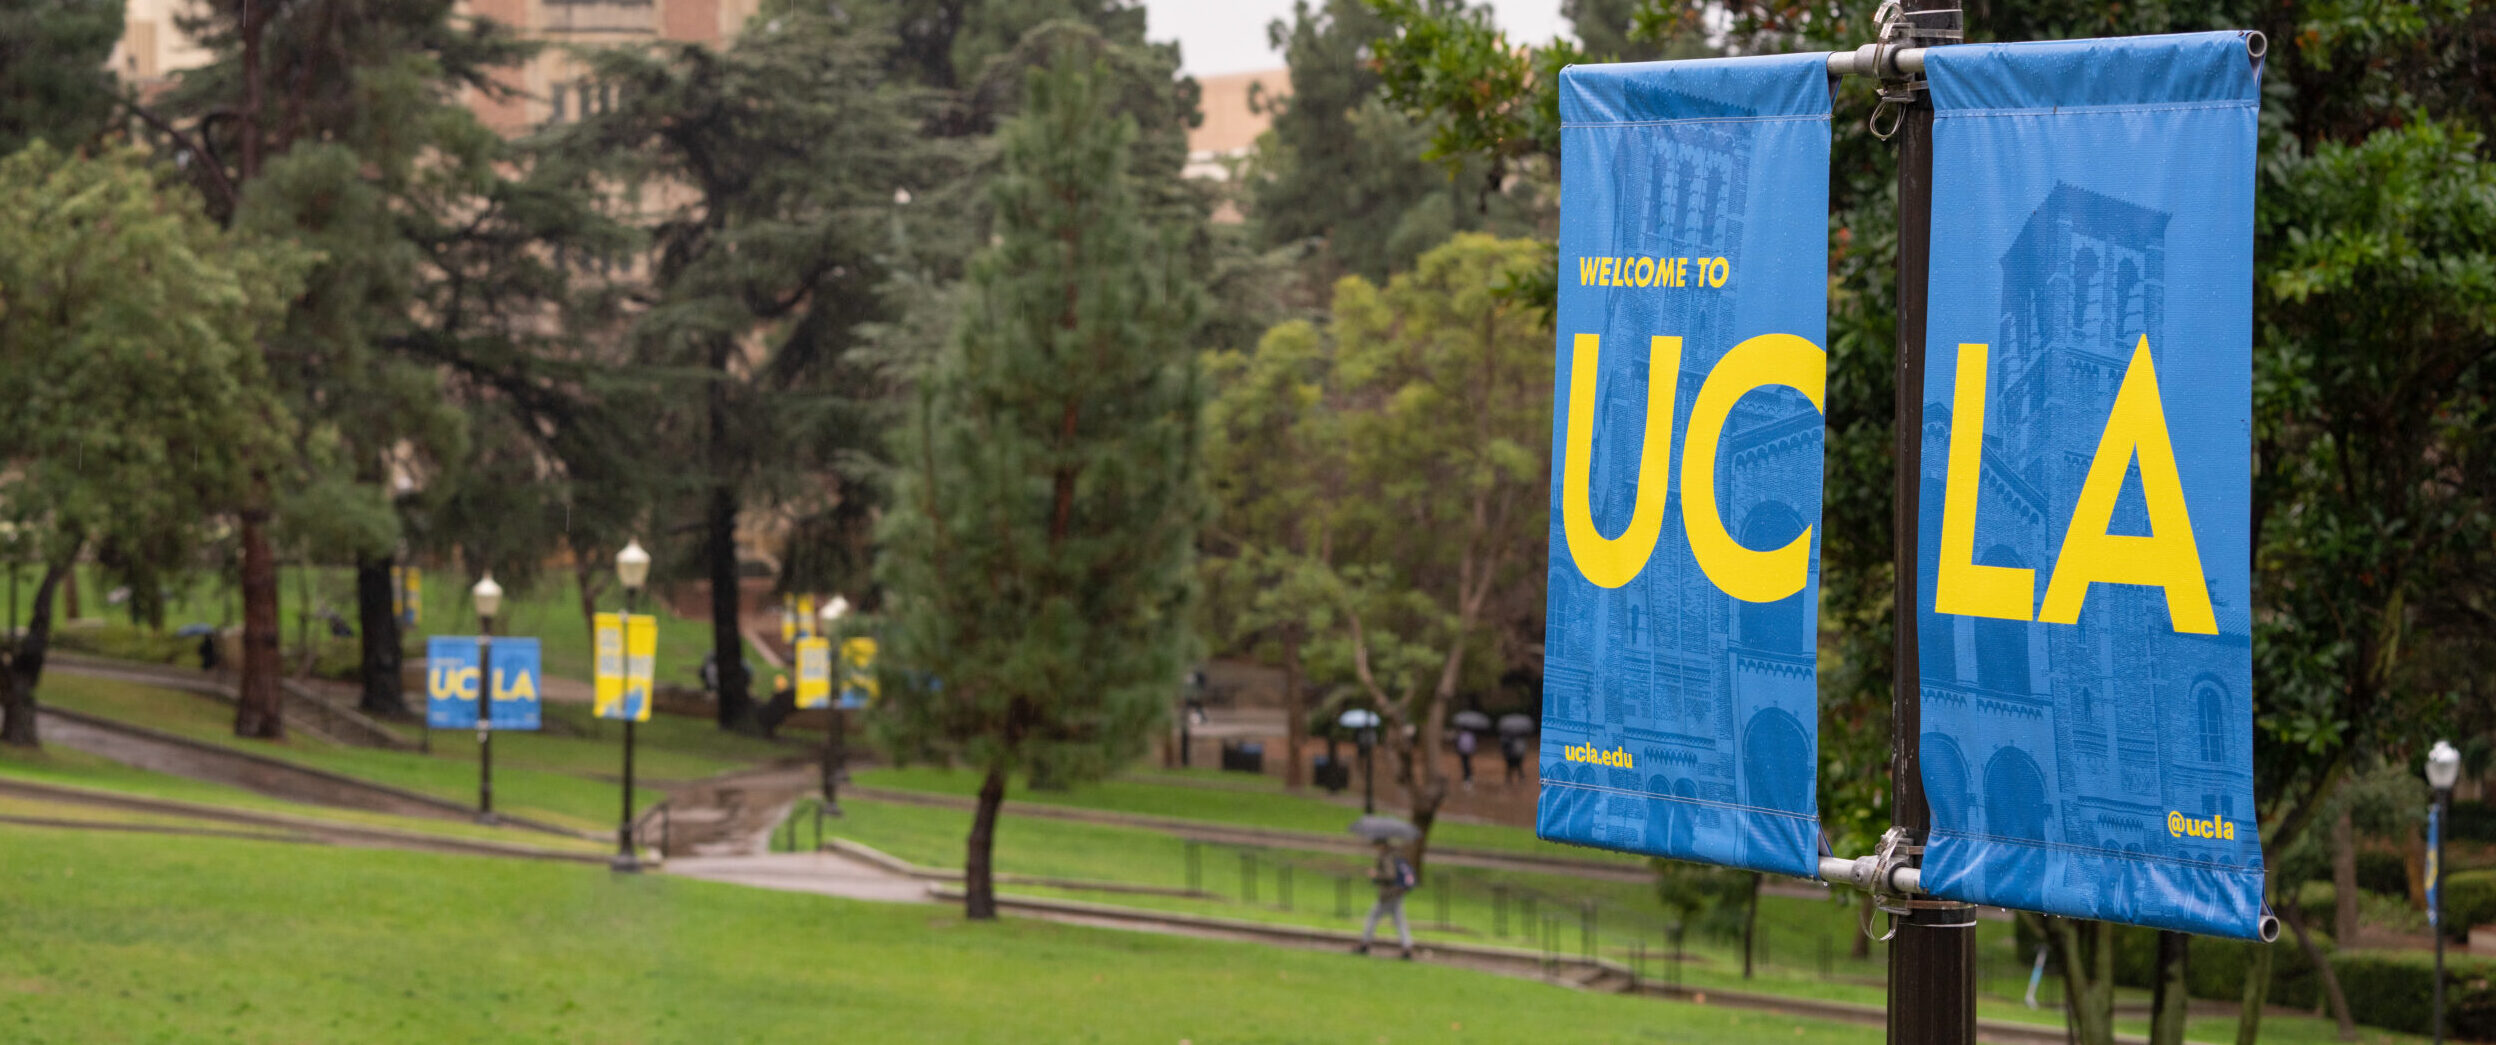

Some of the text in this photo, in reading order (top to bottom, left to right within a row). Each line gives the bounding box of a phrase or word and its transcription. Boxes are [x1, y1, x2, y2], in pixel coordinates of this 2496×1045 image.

[1579, 256, 1730, 289] WELCOME TO
[1564, 741, 1633, 769] ucla.edu
[2167, 810, 2234, 841] @ucla
